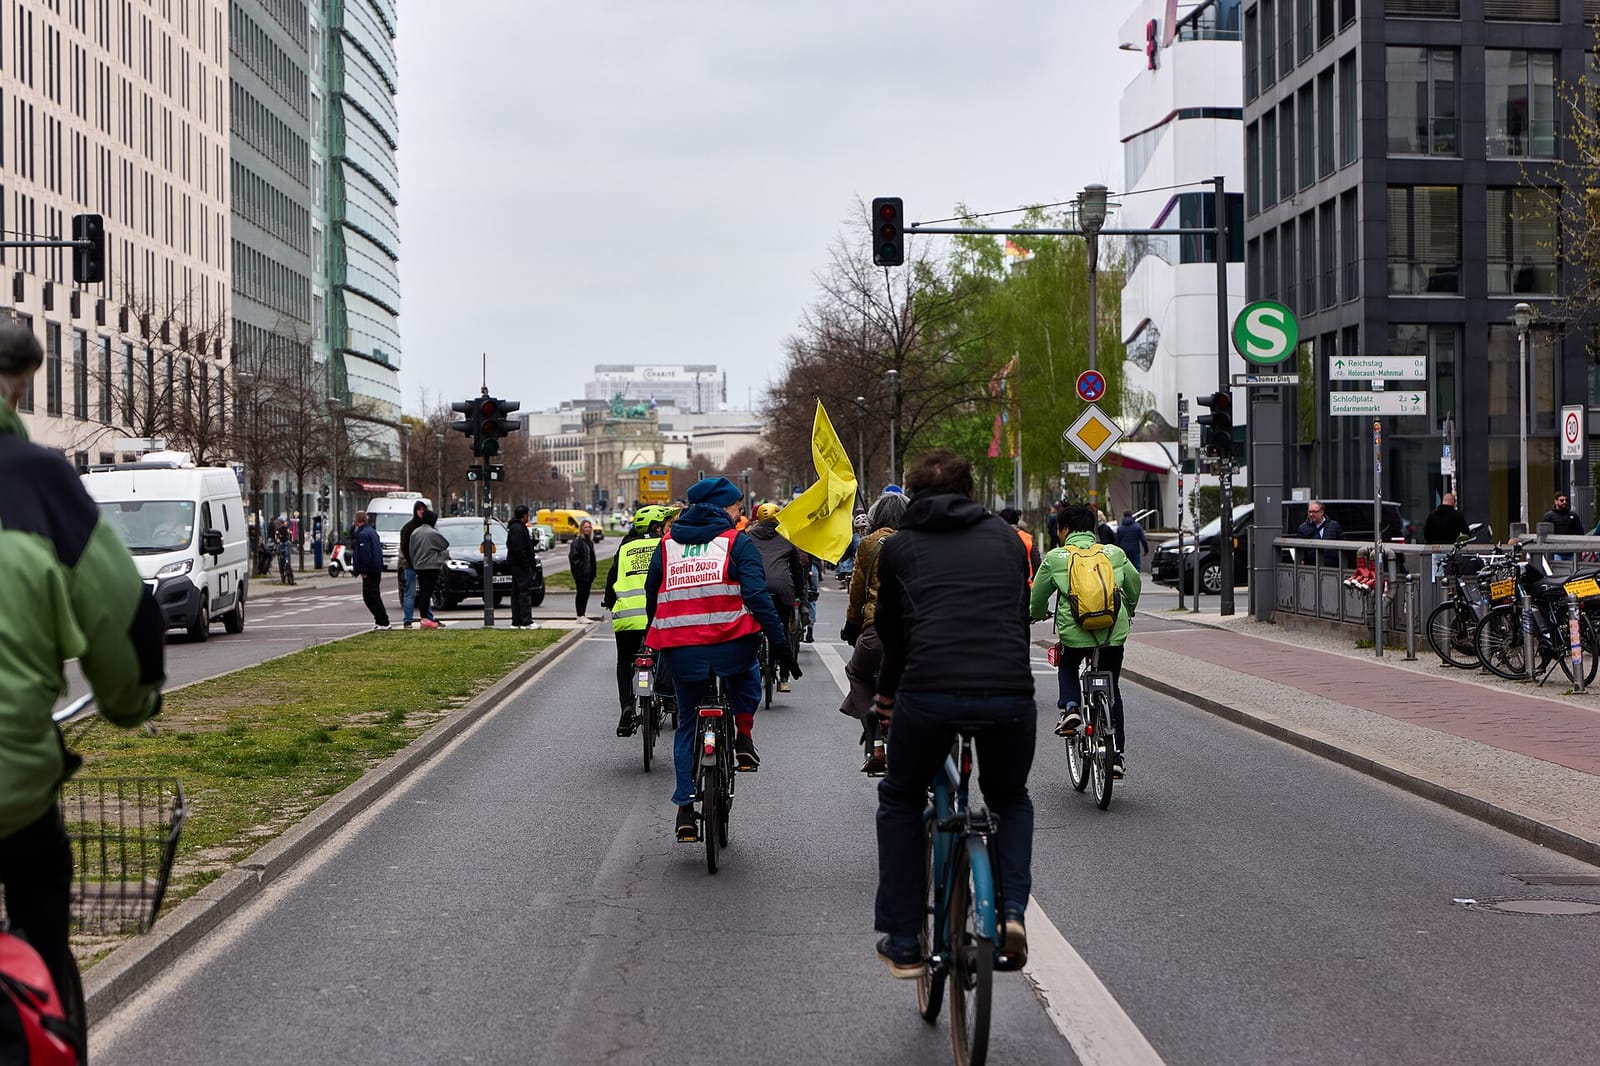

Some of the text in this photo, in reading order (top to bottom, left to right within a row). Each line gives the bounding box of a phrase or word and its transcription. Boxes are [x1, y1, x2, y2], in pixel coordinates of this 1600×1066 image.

[1246, 308, 1287, 358] S
[1348, 360, 1383, 368] Reichstag
[1348, 369, 1404, 377] Holocaust-Mahnmal
[1332, 395, 1373, 403] Schloßplatz
[1568, 420, 1576, 435] 30
[670, 561, 718, 576] Berlin 2030
[667, 571, 721, 588] Klimaneutral
